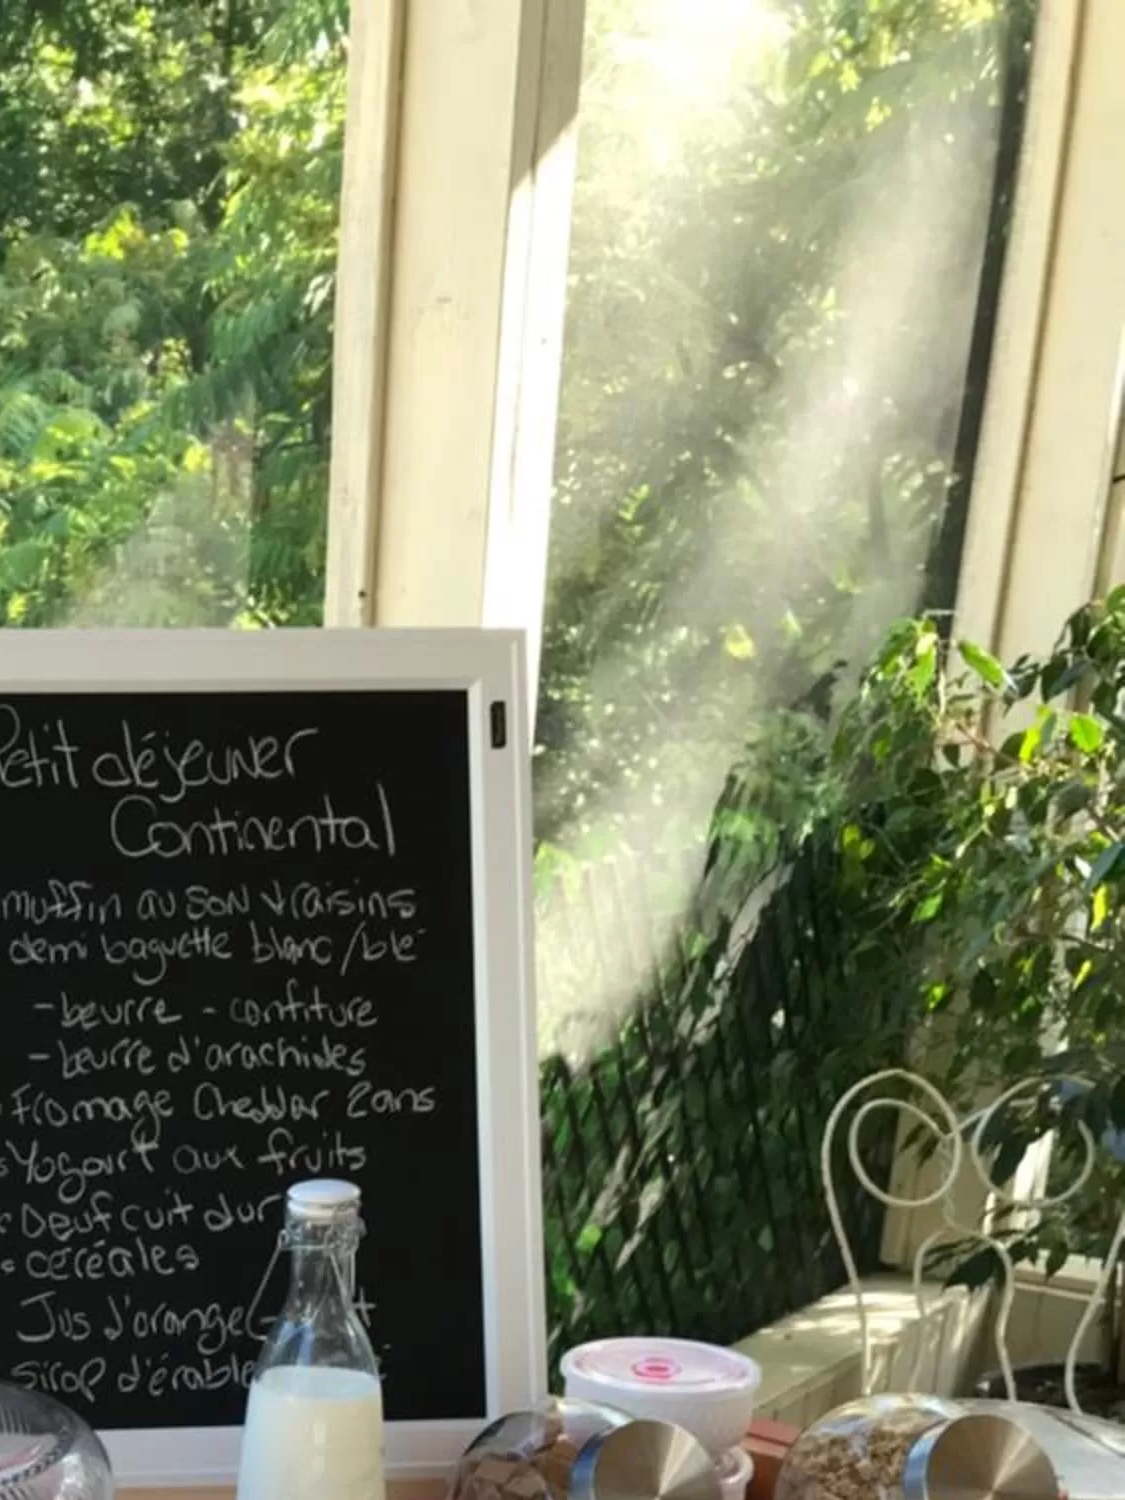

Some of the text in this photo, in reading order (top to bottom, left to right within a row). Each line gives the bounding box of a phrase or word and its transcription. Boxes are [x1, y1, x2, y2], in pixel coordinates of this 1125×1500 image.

[111, 784, 396, 857] Continental
[137, 889, 176, 920] au
[173, 1142, 246, 1174] aux
[257, 1127, 368, 1177] fruits
[120, 1186, 195, 1232] cuit
[16, 1289, 92, 1343] Jus
